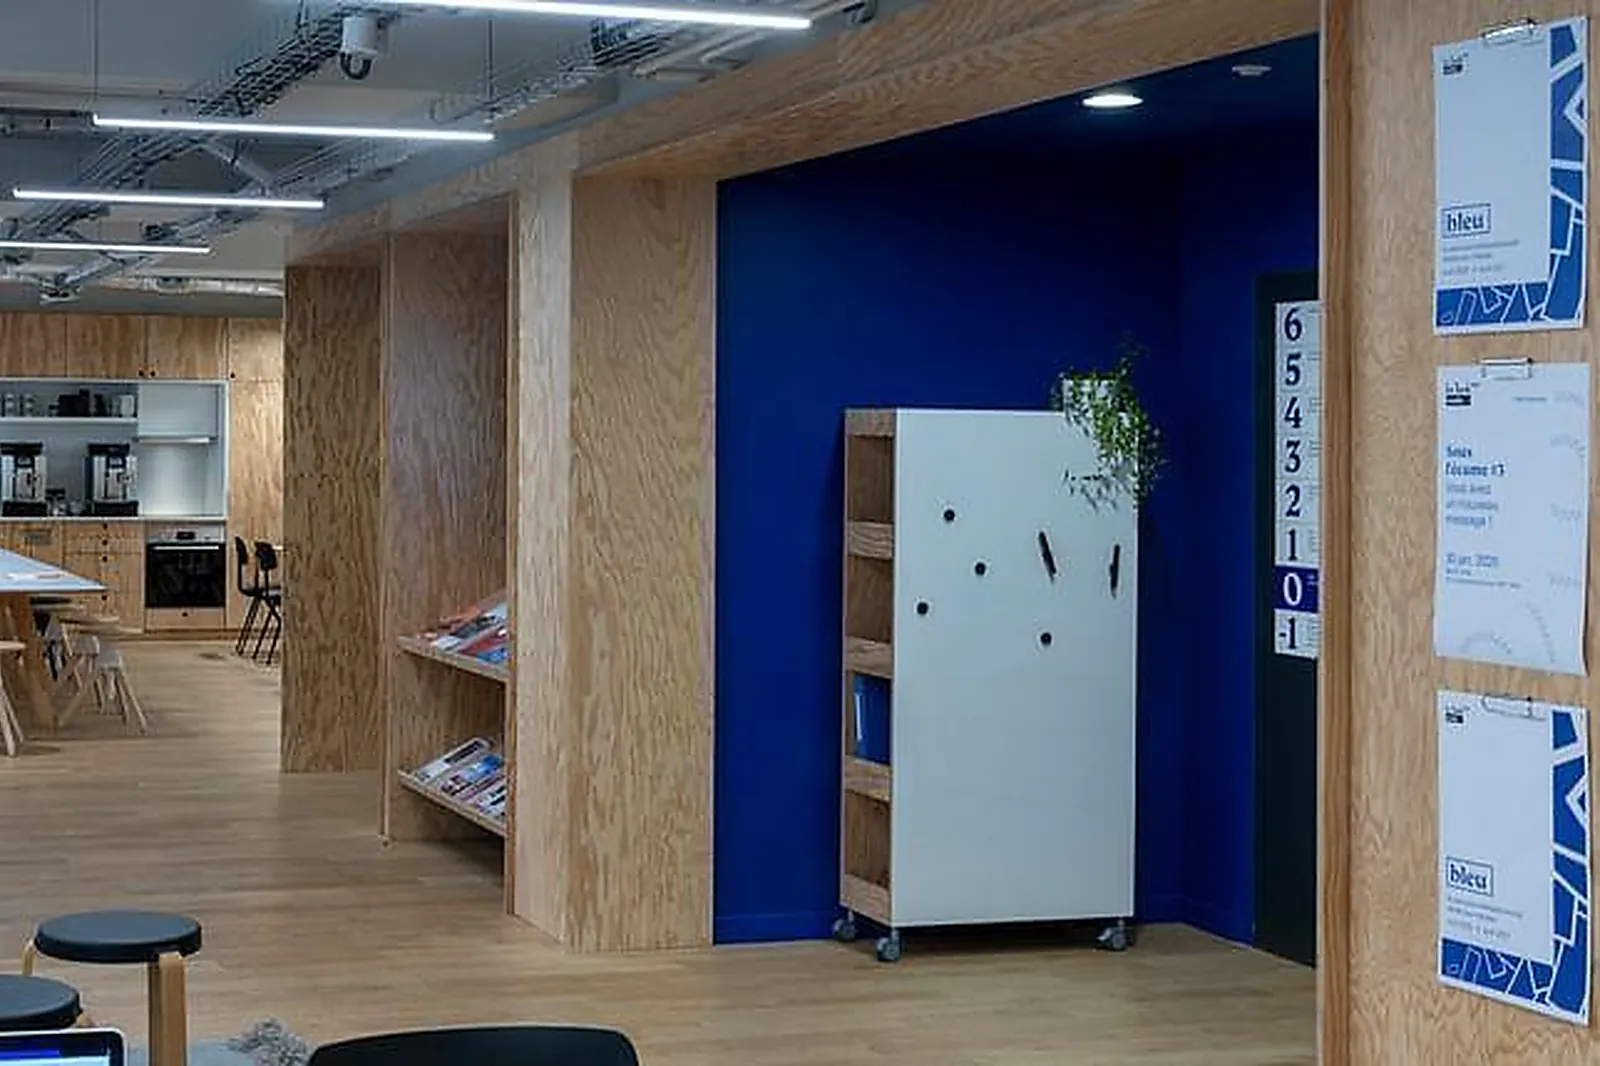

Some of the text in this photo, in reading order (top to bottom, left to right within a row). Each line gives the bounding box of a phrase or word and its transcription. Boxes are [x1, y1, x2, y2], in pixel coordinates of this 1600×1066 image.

[1447, 211, 1484, 232] bleu
[1284, 306, 1303, 341] 6
[1285, 352, 1301, 386] 5
[1284, 396, 1302, 429] 4
[1284, 439, 1301, 473] 3
[1285, 484, 1301, 517] 2
[1287, 527, 1298, 561] 1
[1283, 572, 1303, 606] 0
[1279, 616, 1297, 650] -1
[1450, 863, 1487, 889] bleu
